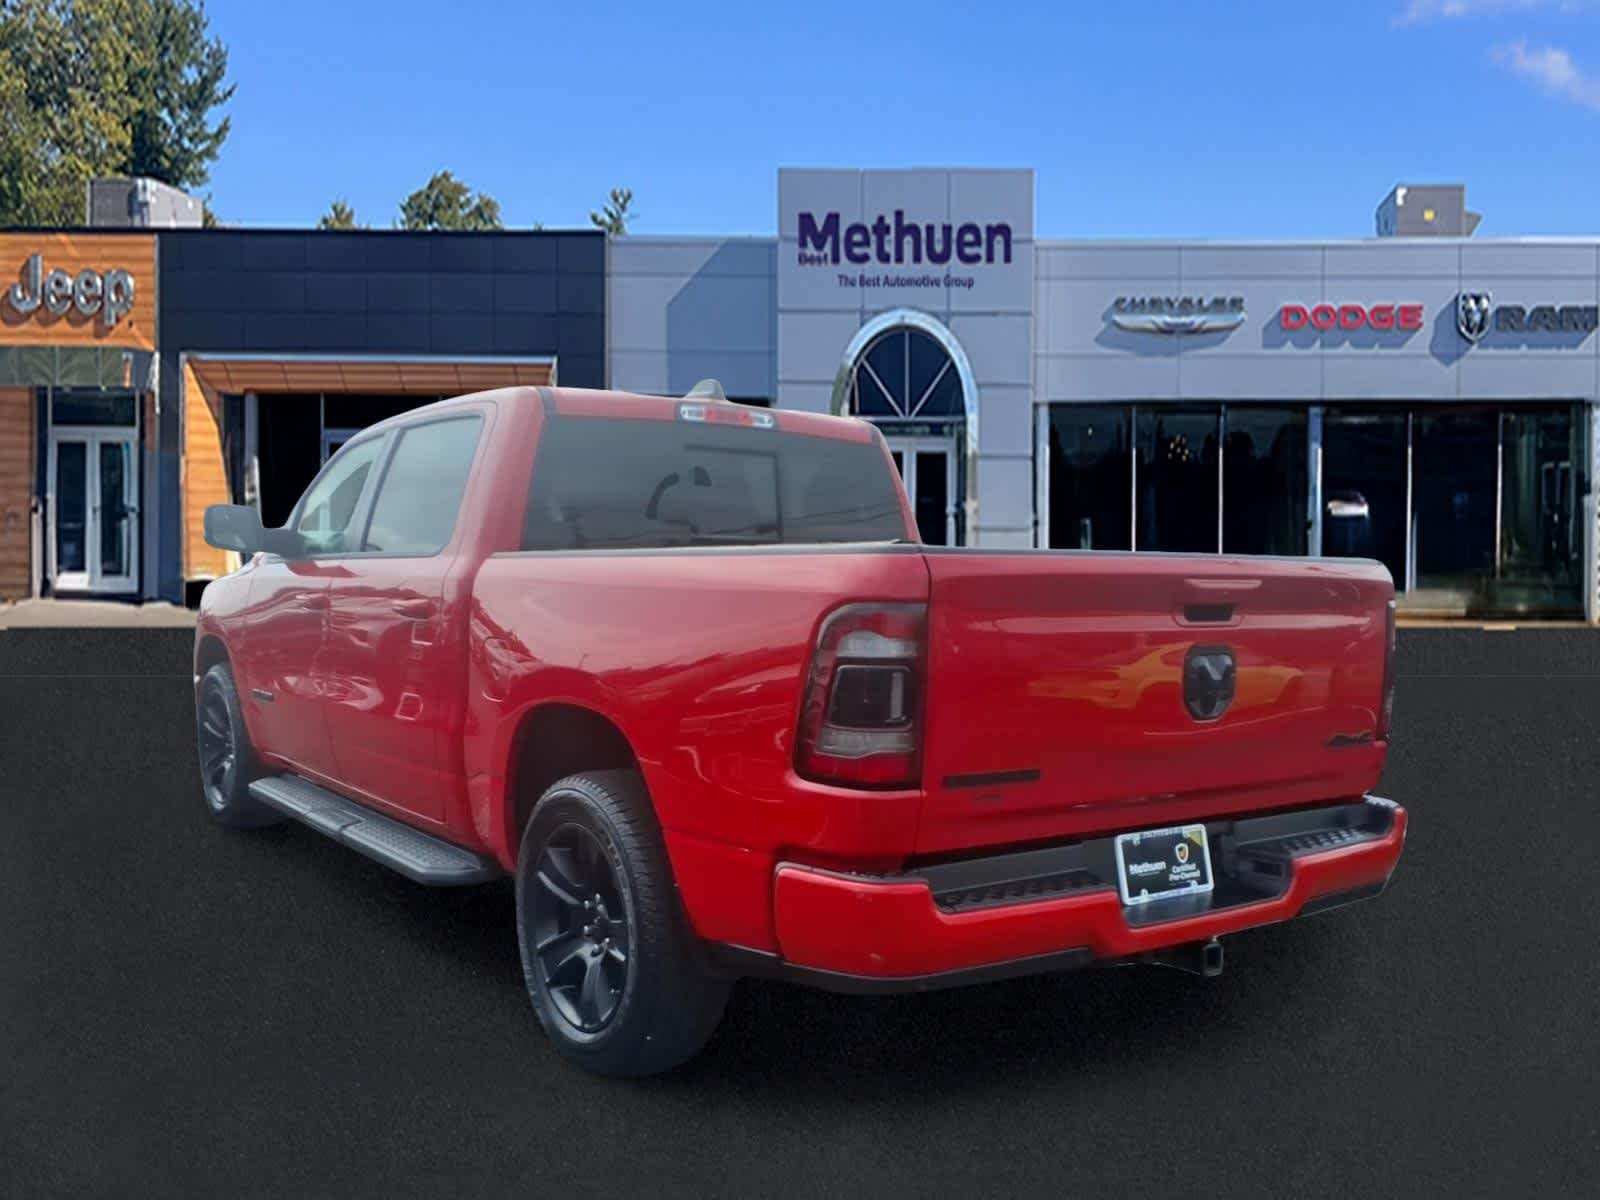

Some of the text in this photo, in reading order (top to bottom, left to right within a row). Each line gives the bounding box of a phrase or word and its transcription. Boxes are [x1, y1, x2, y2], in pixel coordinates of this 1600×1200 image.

[798, 209, 1012, 265] Methuen
[9, 254, 135, 326] Jeep
[838, 274, 974, 290] The Best Automotive Group
[1114, 296, 1244, 314] CHRYSLER
[1282, 304, 1424, 330] DODGE
[1495, 305, 1599, 331] RAM
